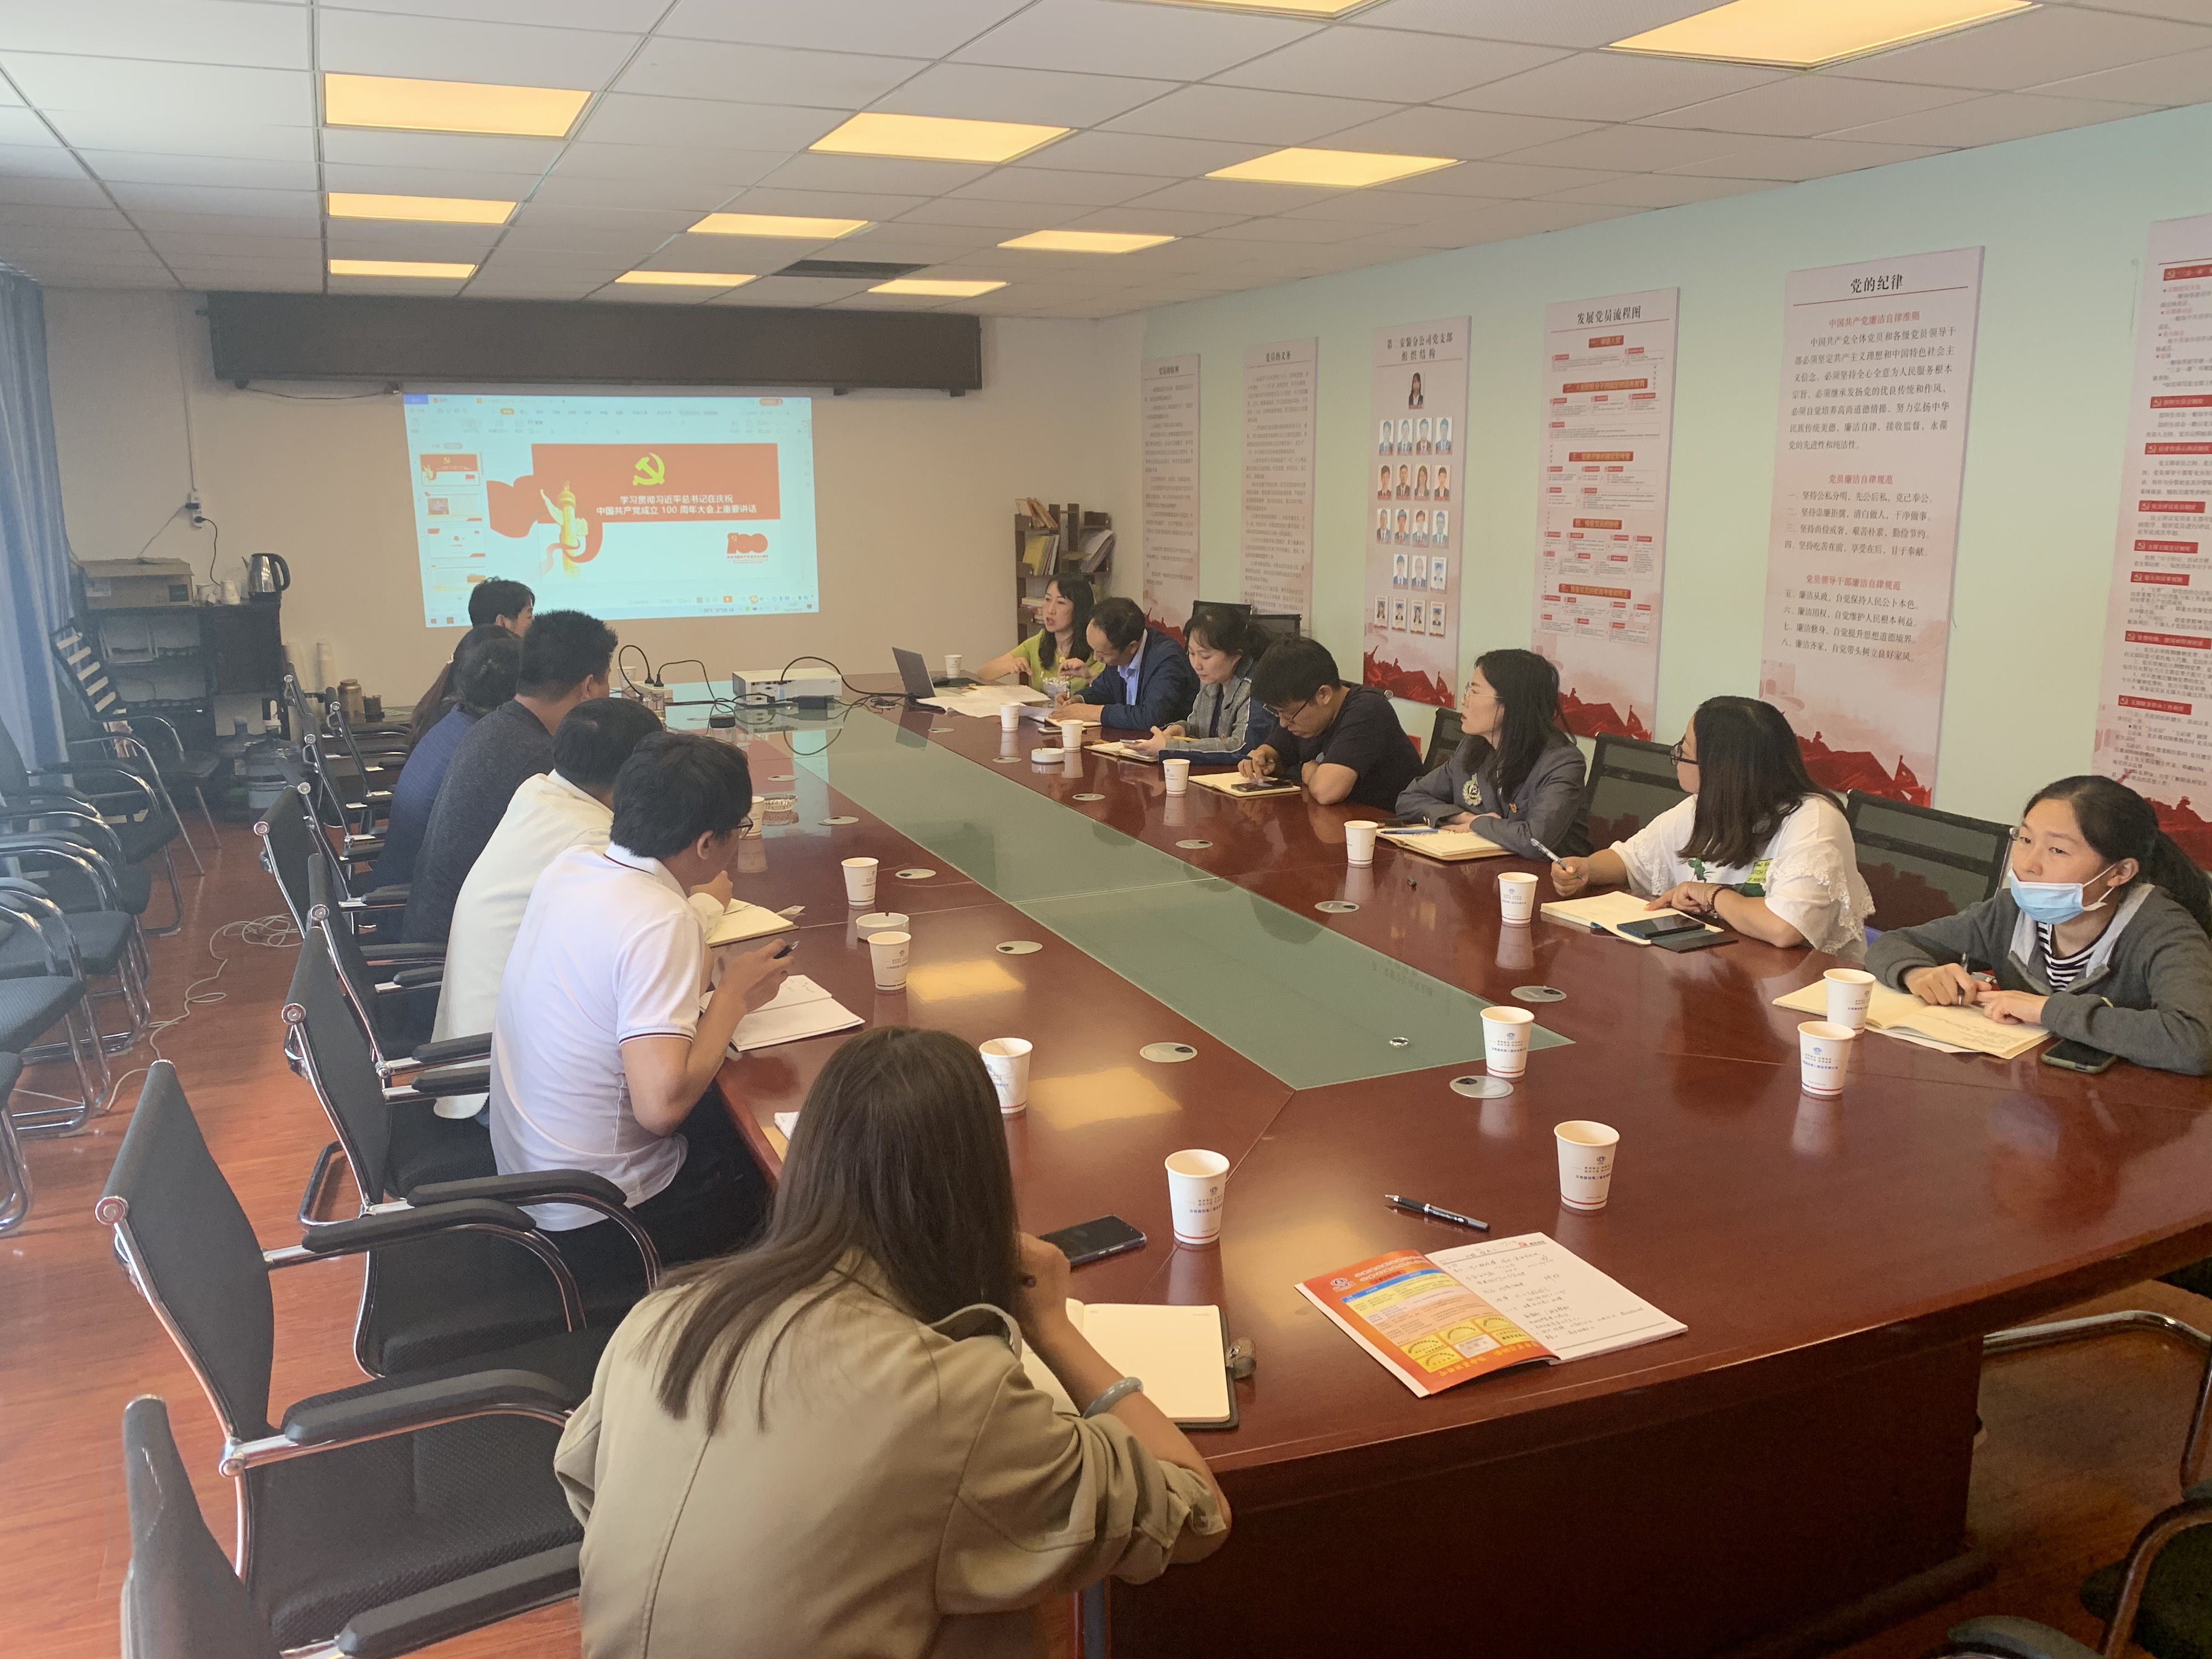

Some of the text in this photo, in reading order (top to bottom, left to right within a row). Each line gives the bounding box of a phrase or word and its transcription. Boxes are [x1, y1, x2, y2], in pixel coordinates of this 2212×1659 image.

[1850, 274, 1904, 294] 党的纪律
[1577, 305, 1641, 325] 发展党员流程图
[1829, 311, 1920, 328] 中国共产党廉洁自律准则
[1810, 326, 1956, 348] 中国共产党全体党员和各级党员领导干
[1266, 351, 1291, 363] 党员的义务
[1401, 349, 1435, 361] 组织结构
[1795, 346, 1954, 366] 部必须坚定共产主义理想和中国特色社会主
[1788, 440, 1860, 450] 党的先进性和纯洁性。
[1829, 474, 1893, 484] 党员廉洁自律规范
[620, 494, 733, 504] 学习贯彻习近平总书记在庆祝
[596, 504, 757, 515] 中国共产党成立 100 周年大会上重要讲话
[1806, 574, 1901, 591] 党员领导干部廉洁自律规范
